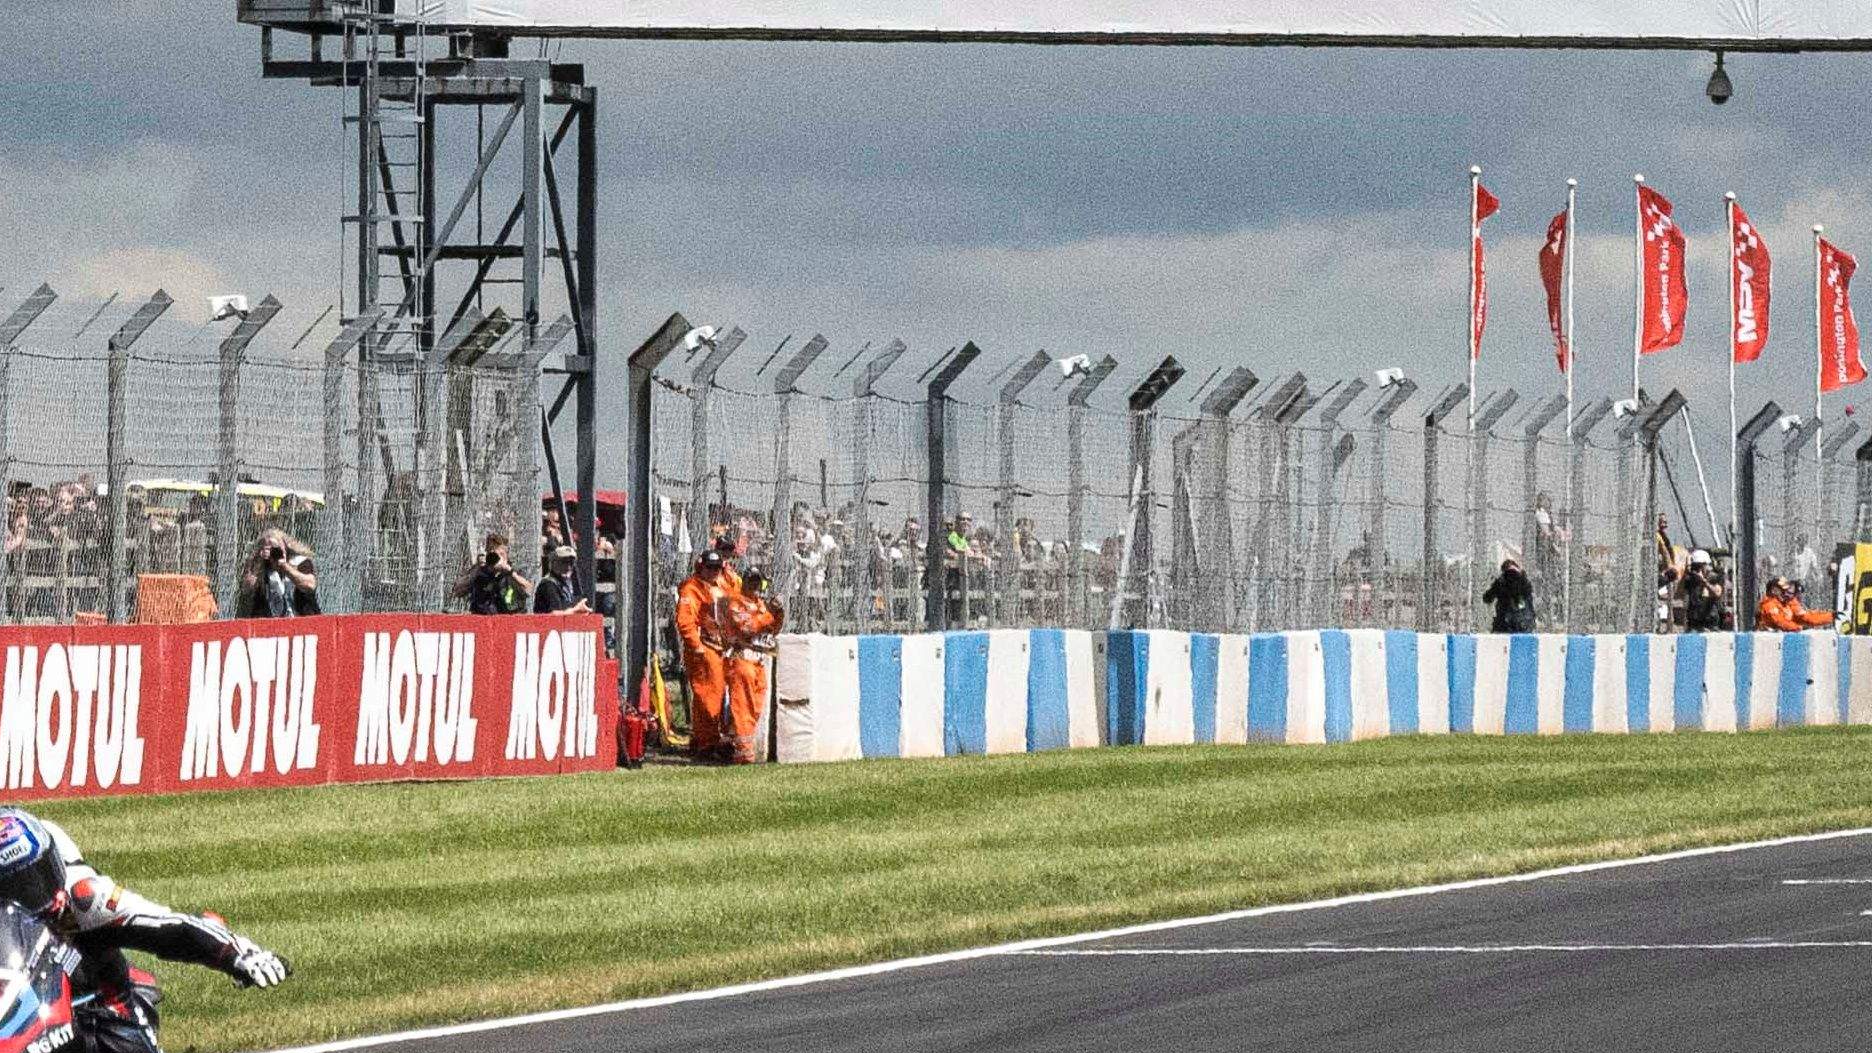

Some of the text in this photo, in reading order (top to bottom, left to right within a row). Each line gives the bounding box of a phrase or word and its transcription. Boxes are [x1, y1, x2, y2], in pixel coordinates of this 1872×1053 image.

[180, 634, 321, 781] MOTUL
[354, 629, 478, 766] MOTUL
[505, 629, 598, 762] MOTUL
